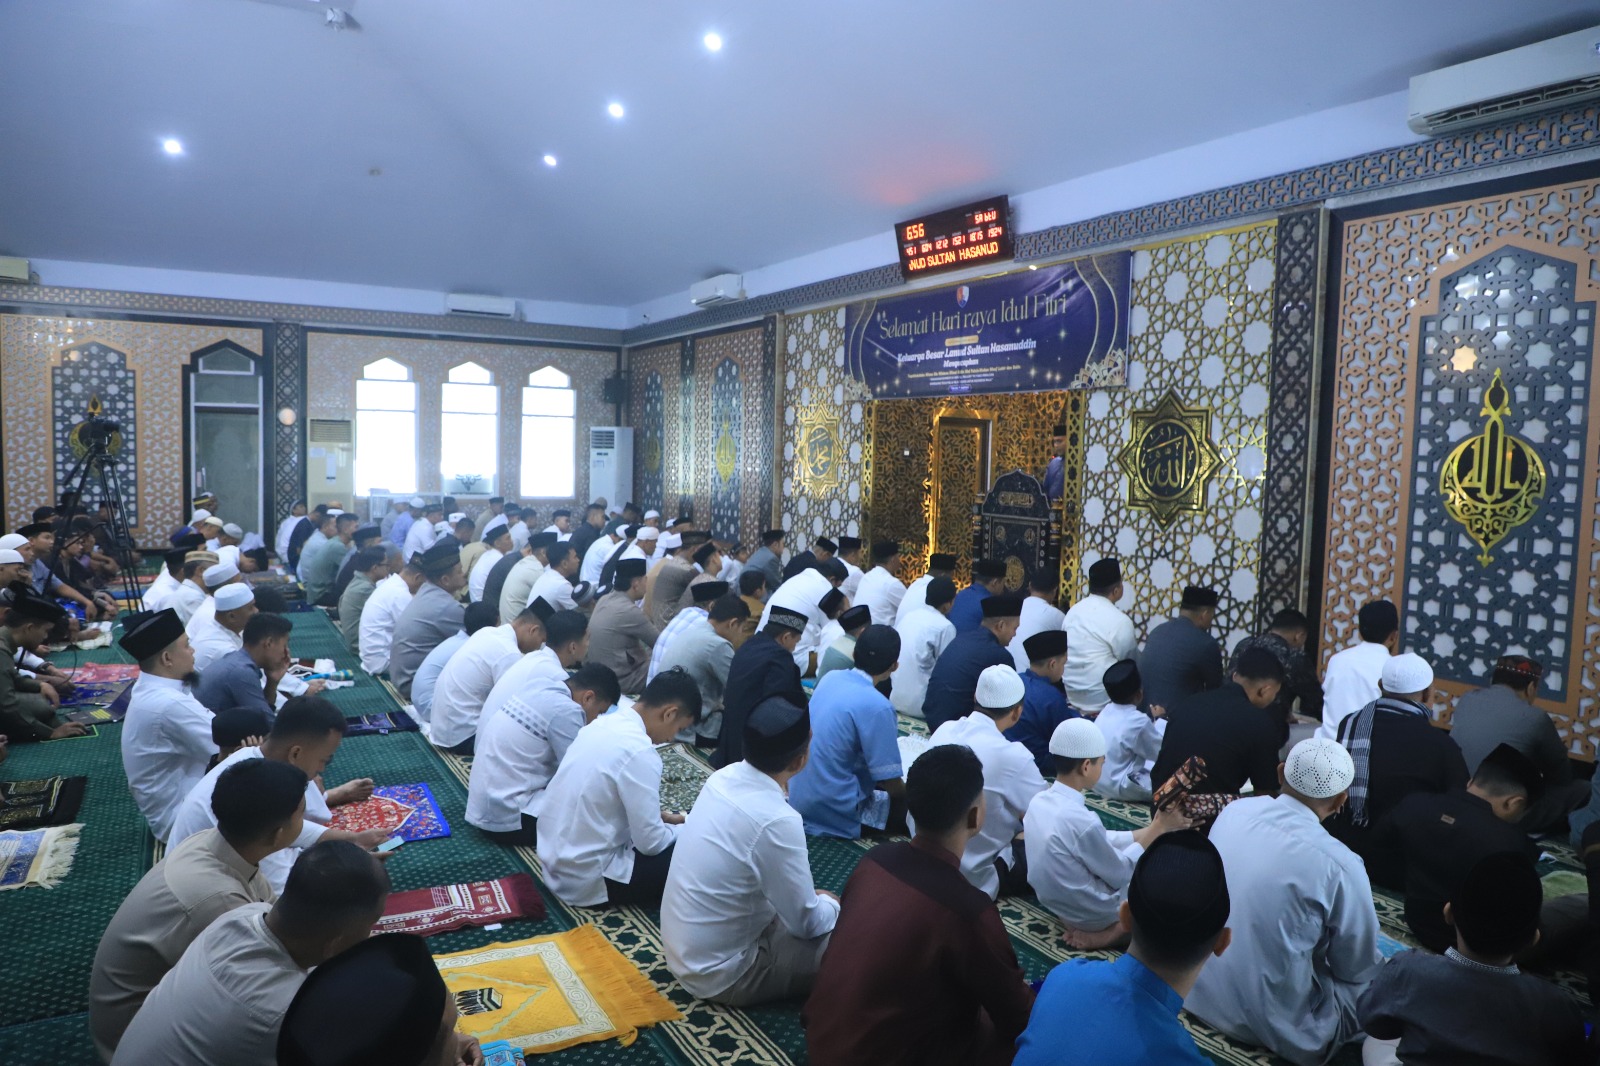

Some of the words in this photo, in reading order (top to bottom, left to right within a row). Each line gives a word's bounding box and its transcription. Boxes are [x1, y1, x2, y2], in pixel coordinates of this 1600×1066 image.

[927, 250, 956, 267] SULTAN
[959, 241, 998, 260] HASANUD
[880, 315, 929, 339] Selamat
[931, 310, 961, 333] Hari
[964, 309, 996, 334] raya
[1001, 295, 1028, 323] Idul
[1033, 293, 1066, 318] Fitri
[925, 350, 945, 360] Besar
[944, 347, 967, 358] Lanud
[966, 344, 990, 355] Sultan
[990, 337, 1037, 354] Hasanuddin
